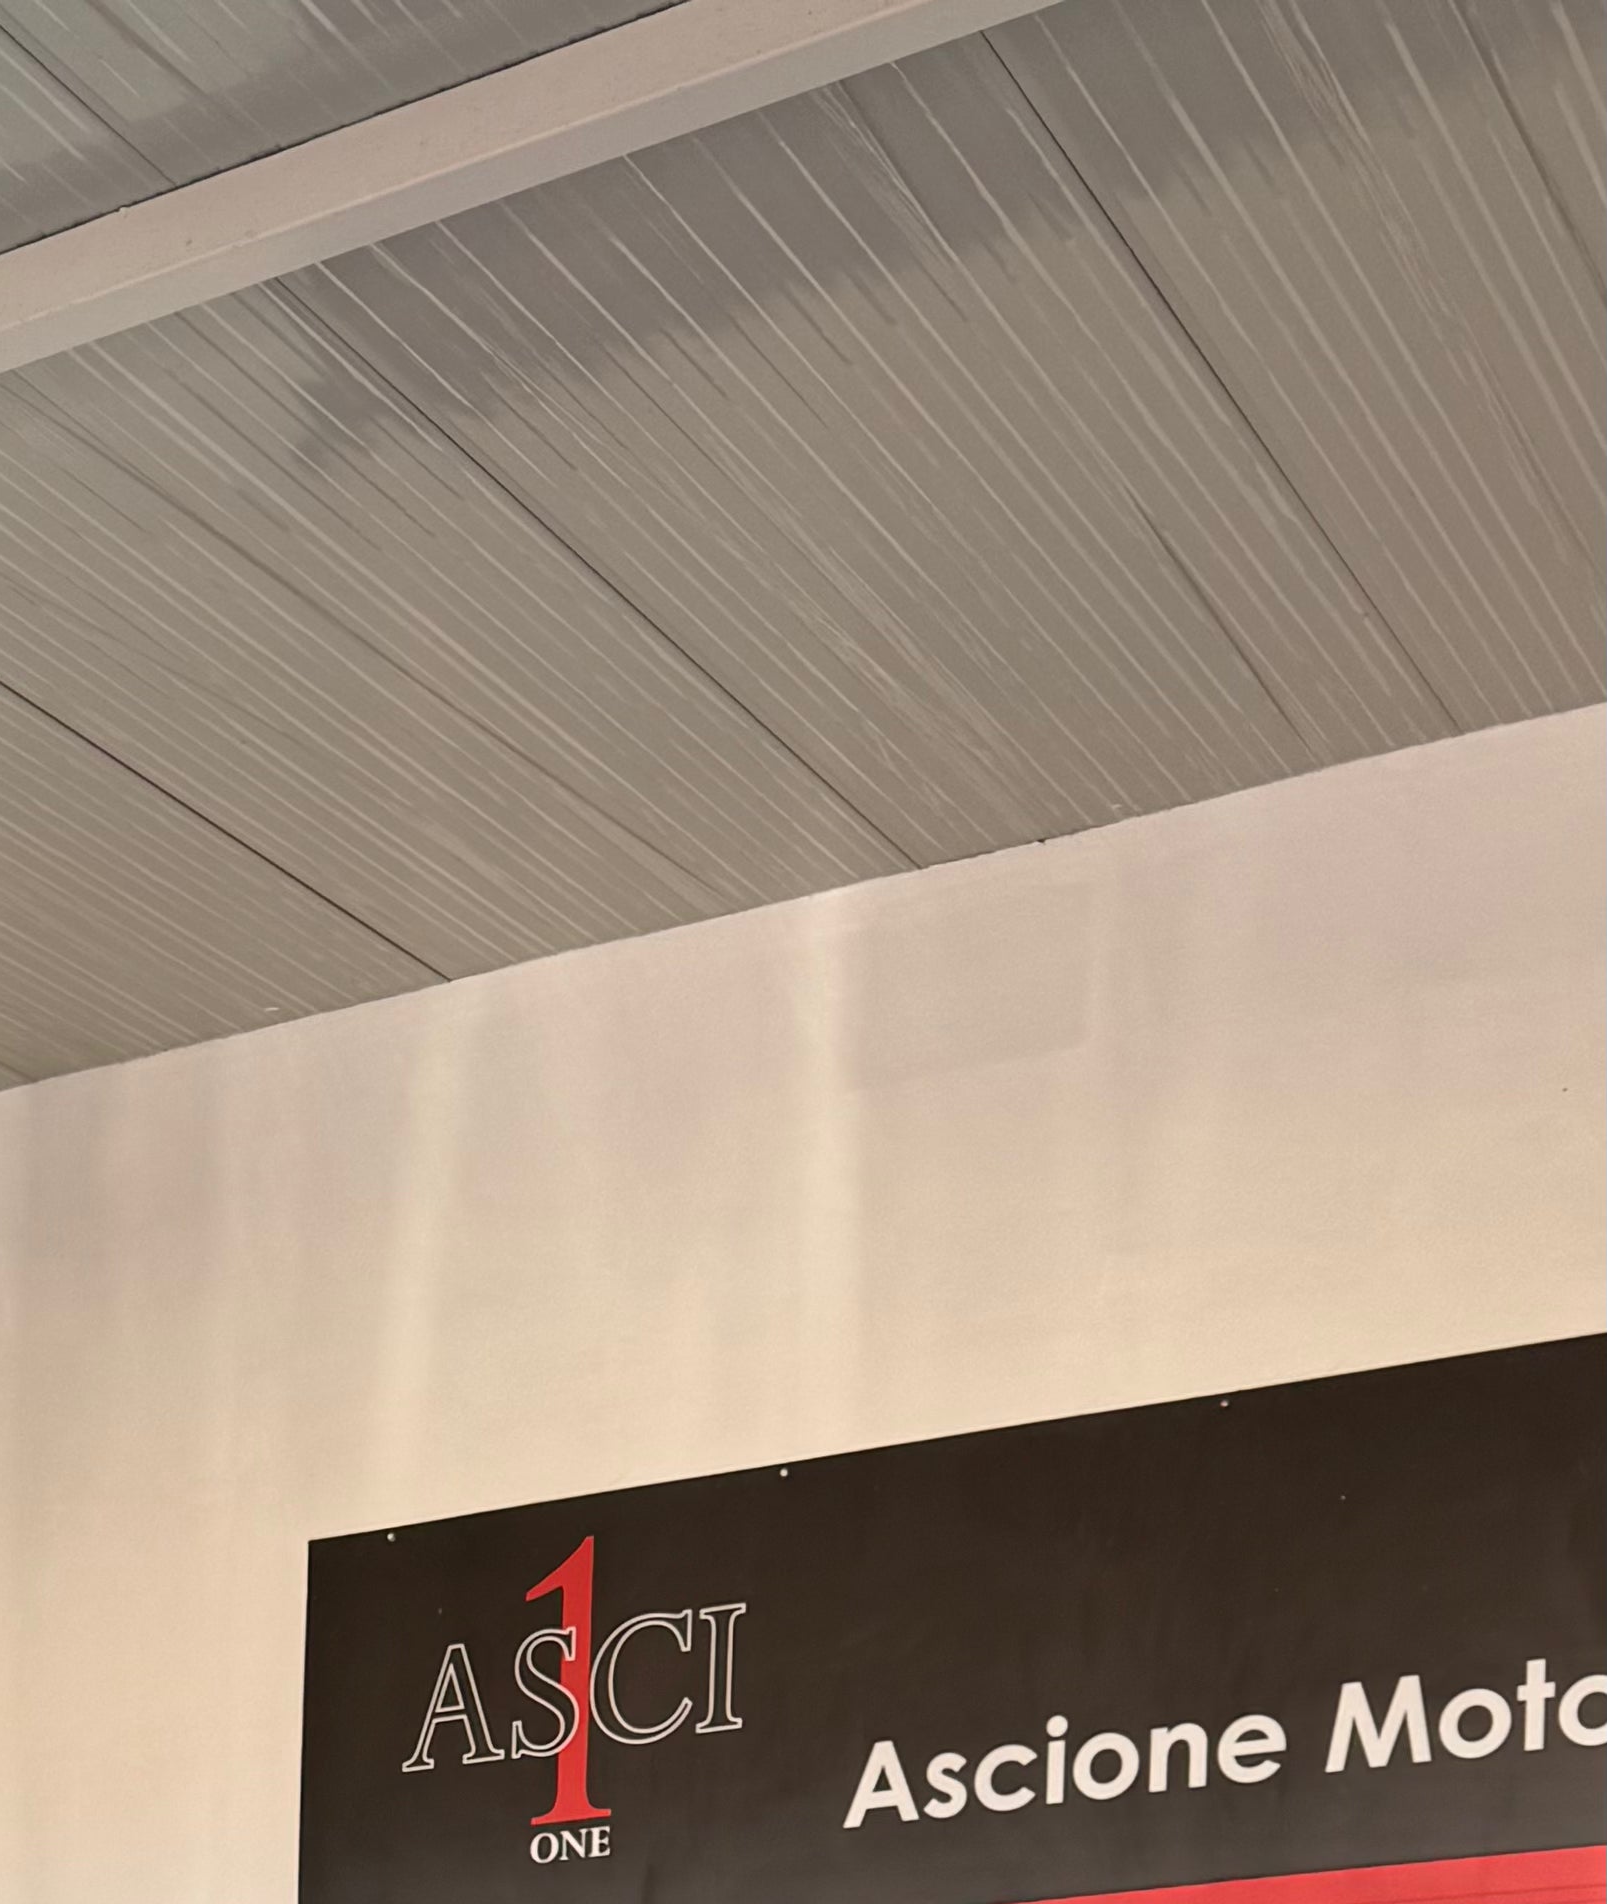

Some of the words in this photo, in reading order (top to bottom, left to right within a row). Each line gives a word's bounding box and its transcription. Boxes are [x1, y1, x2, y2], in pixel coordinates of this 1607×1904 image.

[402, 1602, 746, 1773] ASCI
[842, 1714, 1287, 1829] Ascione
[1325, 1658, 1607, 1773] Moto
[530, 1826, 611, 1864] ONE
